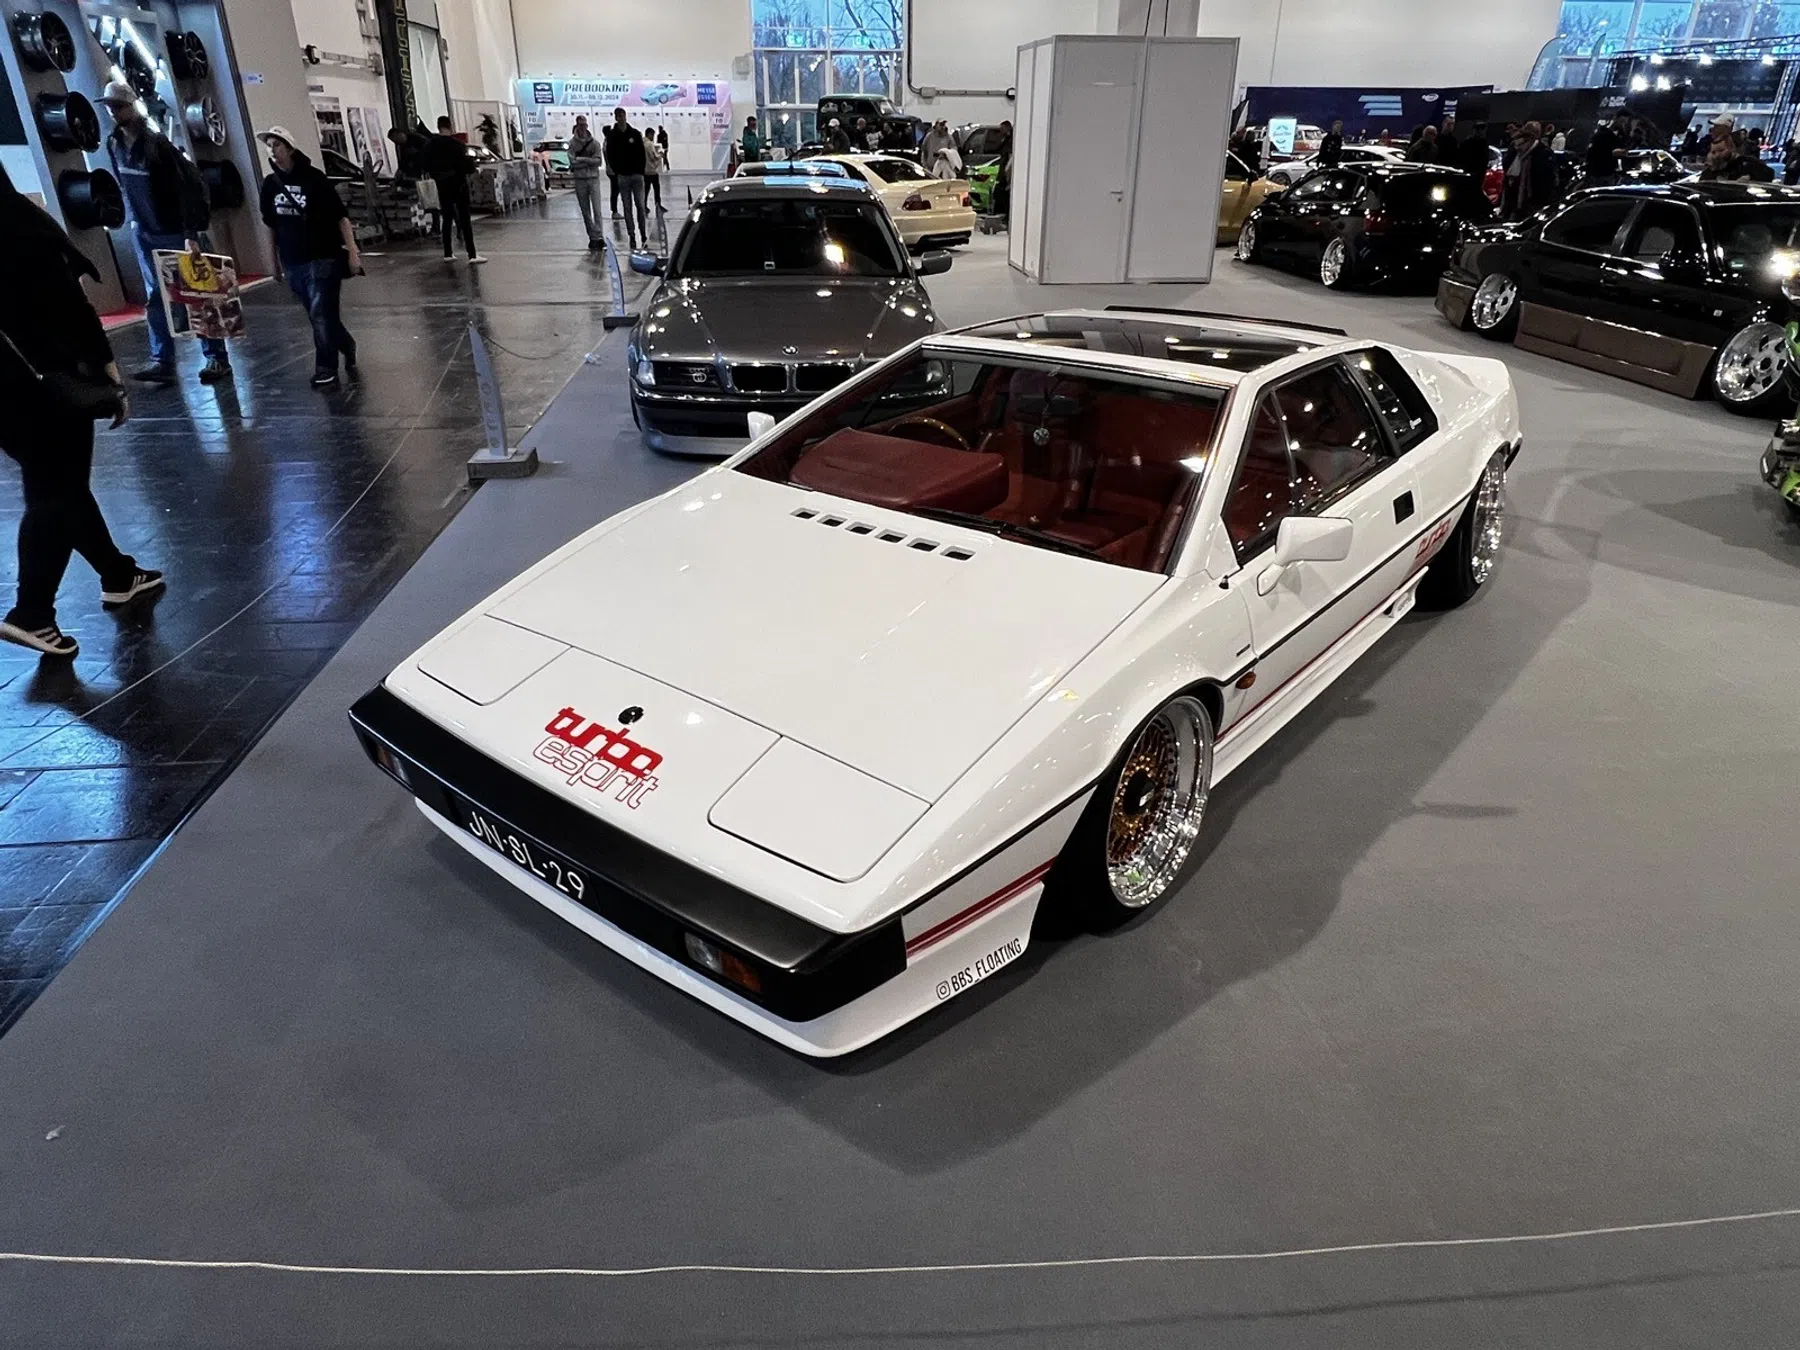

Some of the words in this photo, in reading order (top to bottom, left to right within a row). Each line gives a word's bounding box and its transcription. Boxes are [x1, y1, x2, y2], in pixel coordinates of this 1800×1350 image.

[565, 83, 629, 92] PREBOOKING
[533, 736, 659, 809] esprit
[545, 707, 663, 778] turbo
[951, 938, 1022, 992] BBS_FLOATING
